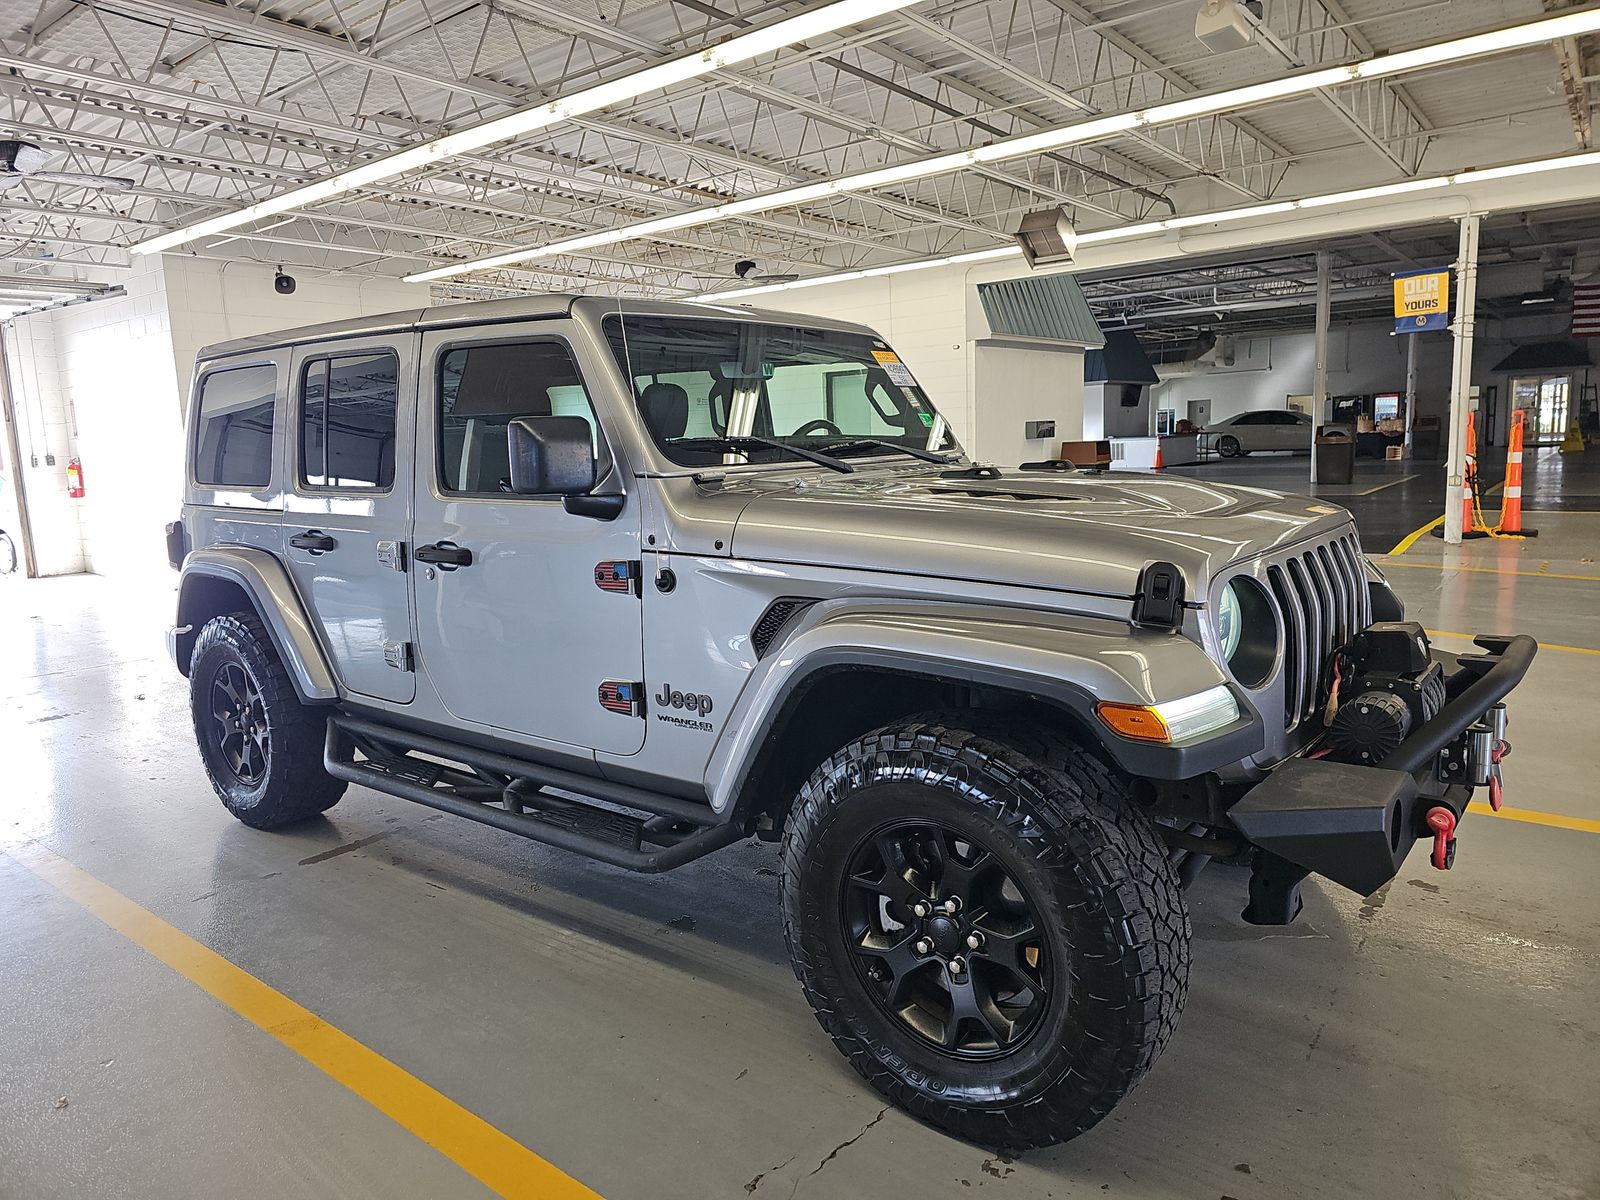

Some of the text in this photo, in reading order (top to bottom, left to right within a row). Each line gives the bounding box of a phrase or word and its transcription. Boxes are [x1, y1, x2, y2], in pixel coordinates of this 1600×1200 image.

[1404, 276, 1439, 295] OUR
[1405, 298, 1439, 311] YOURS
[655, 683, 713, 717] Jeep
[656, 714, 713, 730] WRANGLER
